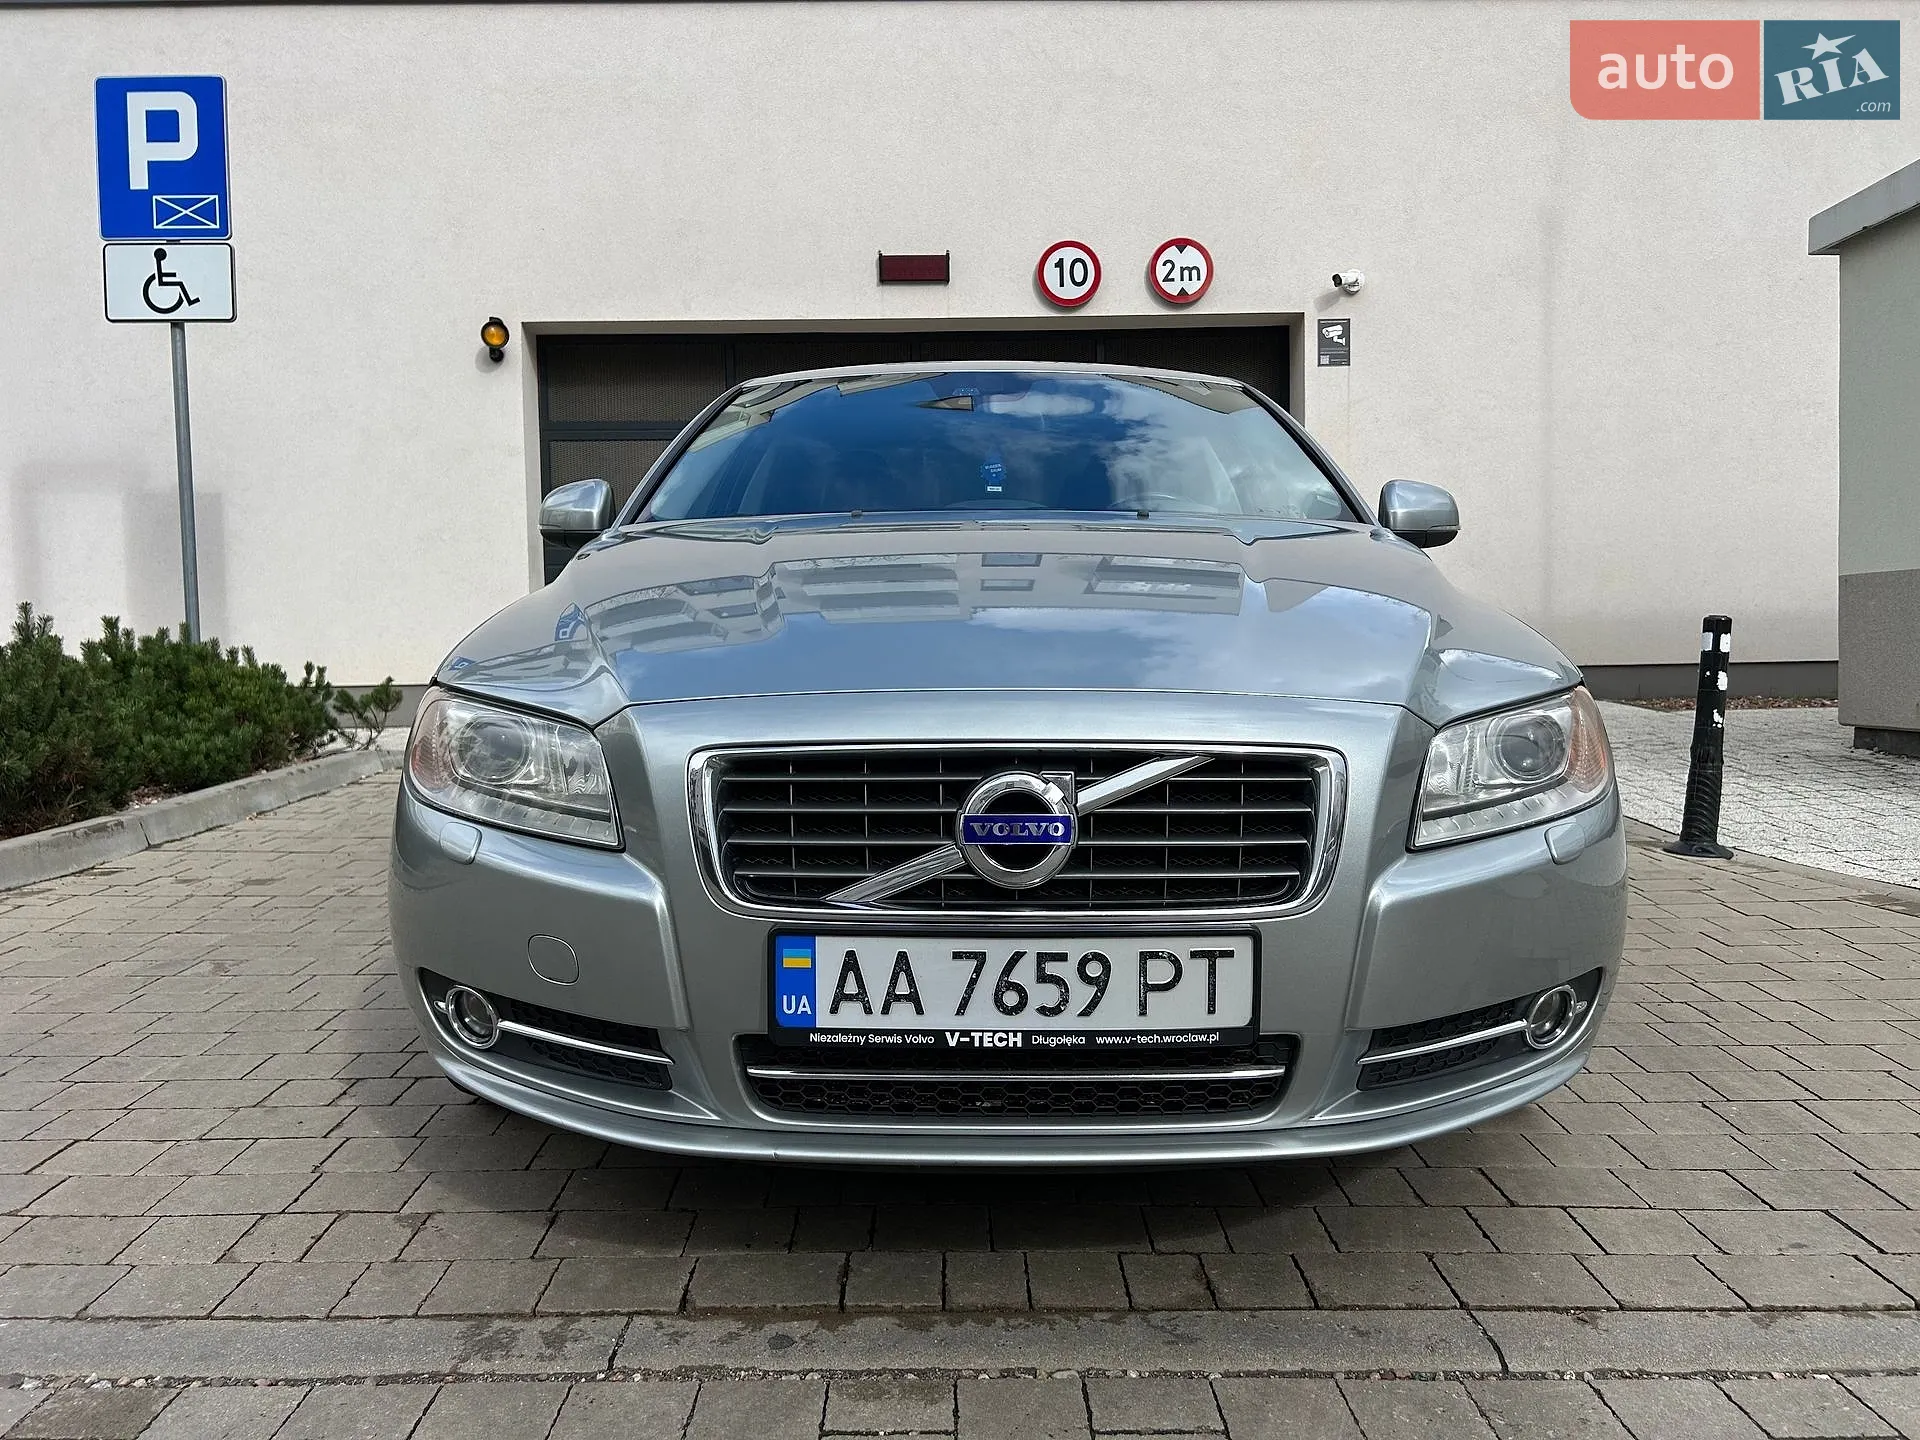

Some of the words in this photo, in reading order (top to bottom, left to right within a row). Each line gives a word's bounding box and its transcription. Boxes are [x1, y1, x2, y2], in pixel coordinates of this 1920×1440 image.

[126, 91, 199, 190] P
[1054, 257, 1089, 288] 10
[969, 822, 1066, 837] VOLVO
[828, 948, 925, 1016] AA
[950, 949, 1113, 1017] 7659
[1136, 949, 1236, 1017] PT
[782, 994, 812, 1015] UA
[809, 1032, 867, 1046] Niezależny
[868, 1033, 903, 1044] Serwis
[904, 1033, 935, 1044] Volvo
[945, 1031, 1023, 1048] V-TECH
[1031, 1034, 1086, 1047] Długołęka
[1095, 1031, 1220, 1045] www.v-tech.wroclaw.pl
